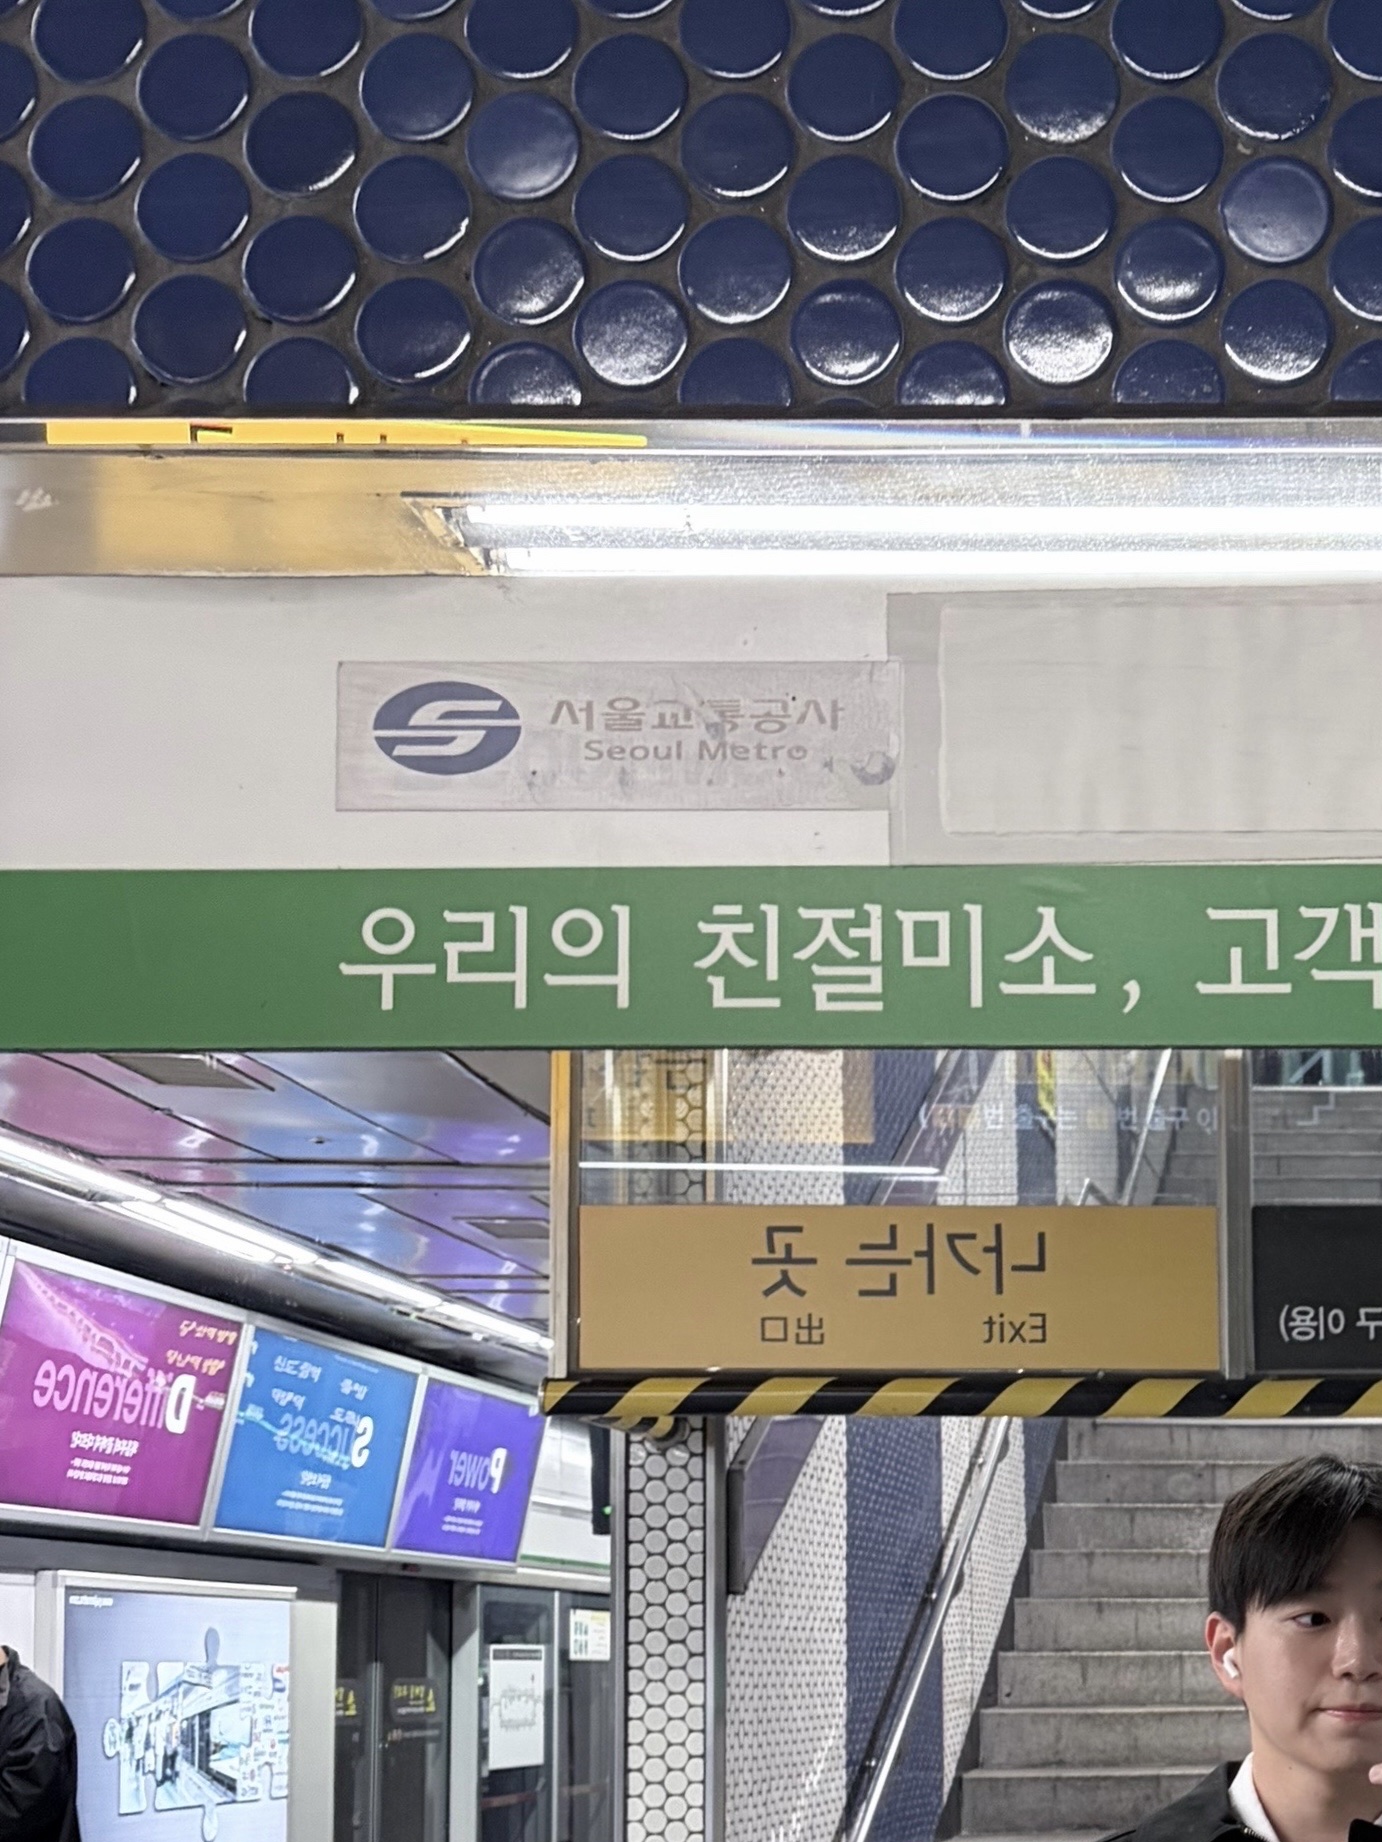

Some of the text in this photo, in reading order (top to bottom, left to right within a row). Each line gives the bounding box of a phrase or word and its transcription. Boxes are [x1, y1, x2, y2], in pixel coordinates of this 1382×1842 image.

[548, 695, 846, 735] 서울교통공사
[583, 738, 809, 763] Seoul Metro
[338, 903, 631, 1011] 우리의
[694, 902, 1141, 1014] 친절미소,
